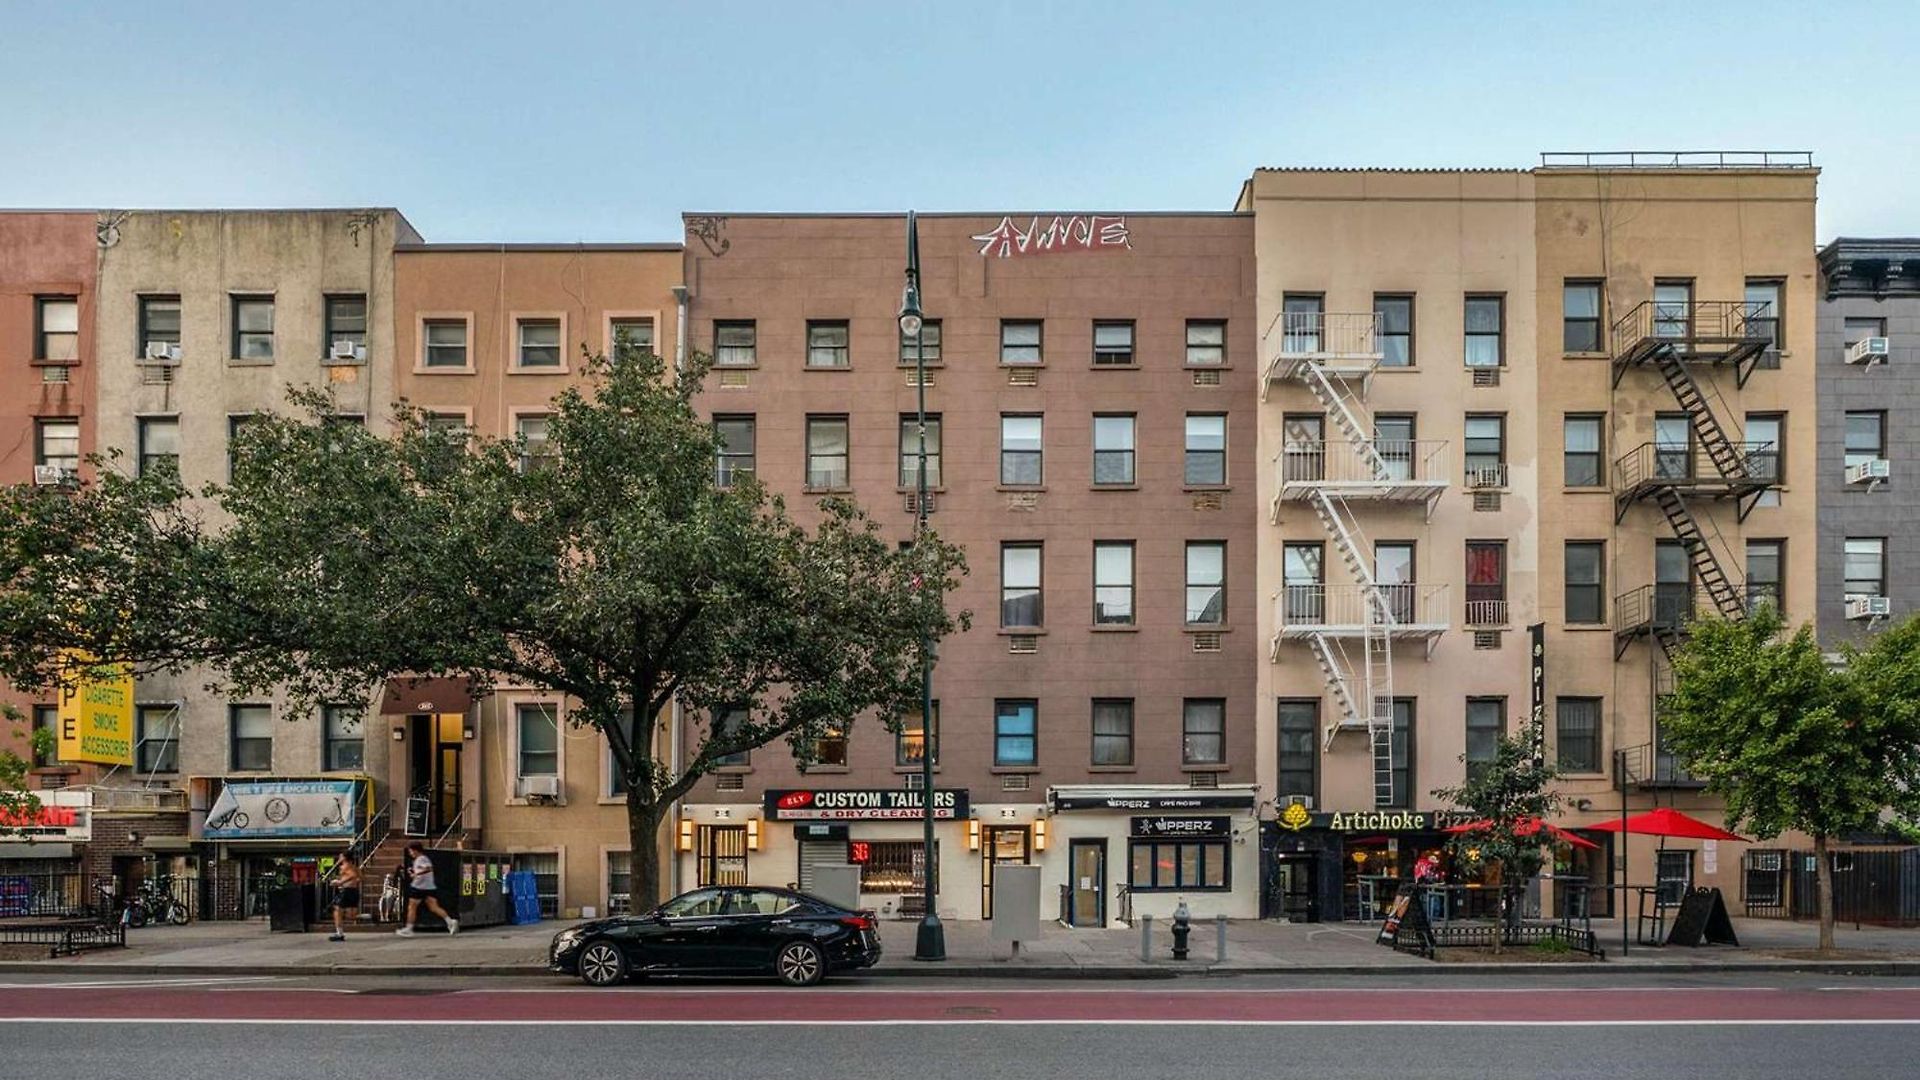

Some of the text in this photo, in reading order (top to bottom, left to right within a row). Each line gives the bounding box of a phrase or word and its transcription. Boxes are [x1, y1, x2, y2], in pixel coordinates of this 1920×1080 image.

[93, 711, 119, 733] SMOKE
[814, 791, 955, 808] CUSTOM TAILRS
[820, 810, 830, 818] &
[835, 810, 865, 818] DRY
[869, 809, 948, 818] CLEANIG
[1330, 810, 1425, 830] Artichoke
